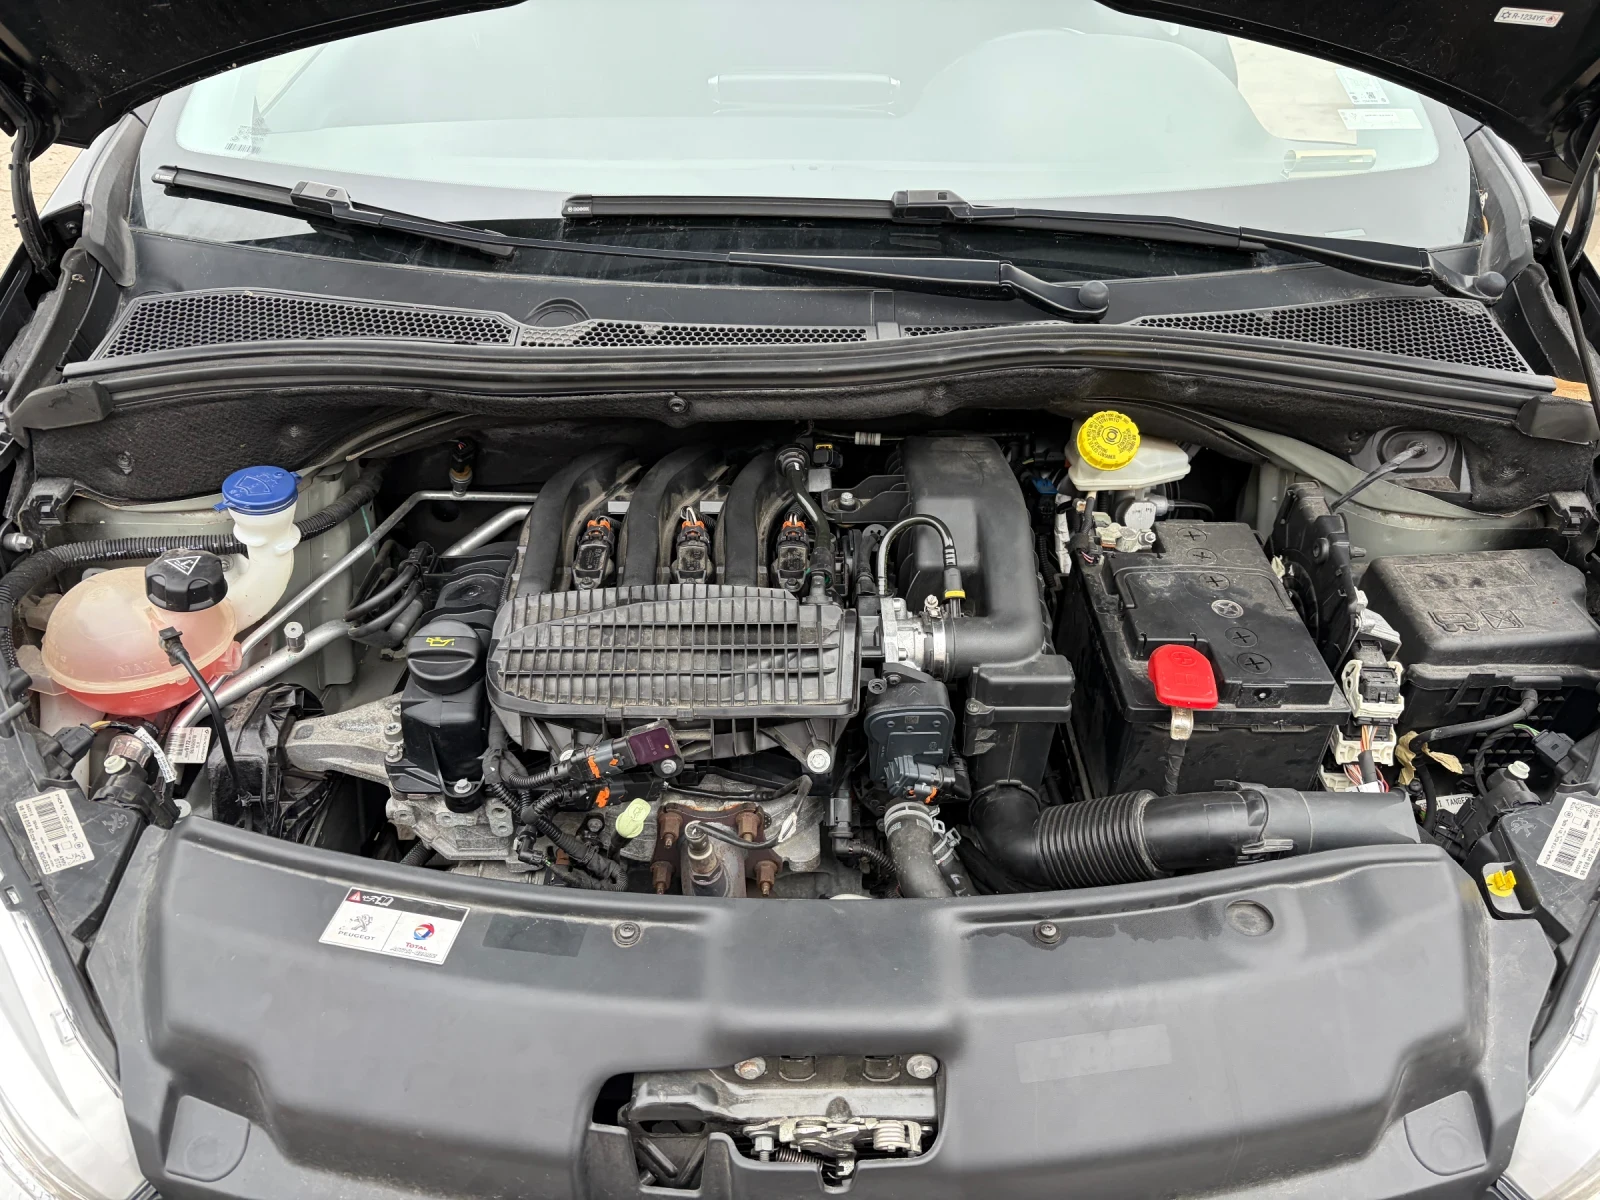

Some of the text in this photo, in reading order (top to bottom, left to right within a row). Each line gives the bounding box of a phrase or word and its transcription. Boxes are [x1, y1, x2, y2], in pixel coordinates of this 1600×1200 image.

[117, 660, 157, 674] MAX
[338, 930, 376, 940] PEUGEOT
[405, 941, 428, 951] TOTAL
